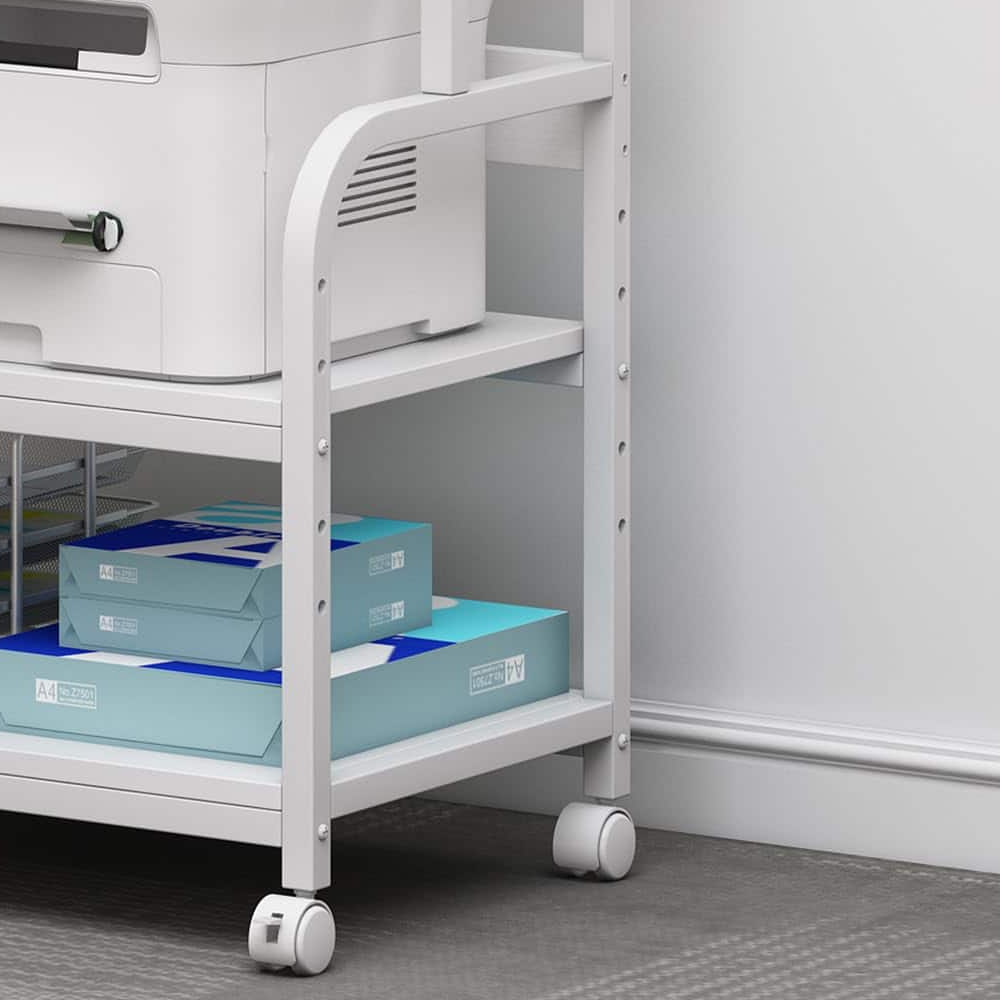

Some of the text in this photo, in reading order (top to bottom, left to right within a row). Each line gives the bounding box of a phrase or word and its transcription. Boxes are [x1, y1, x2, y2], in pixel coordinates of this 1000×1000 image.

[101, 566, 112, 579] A4
[101, 616, 112, 630] A4
[507, 657, 524, 682] A4
[37, 681, 56, 701] A4
